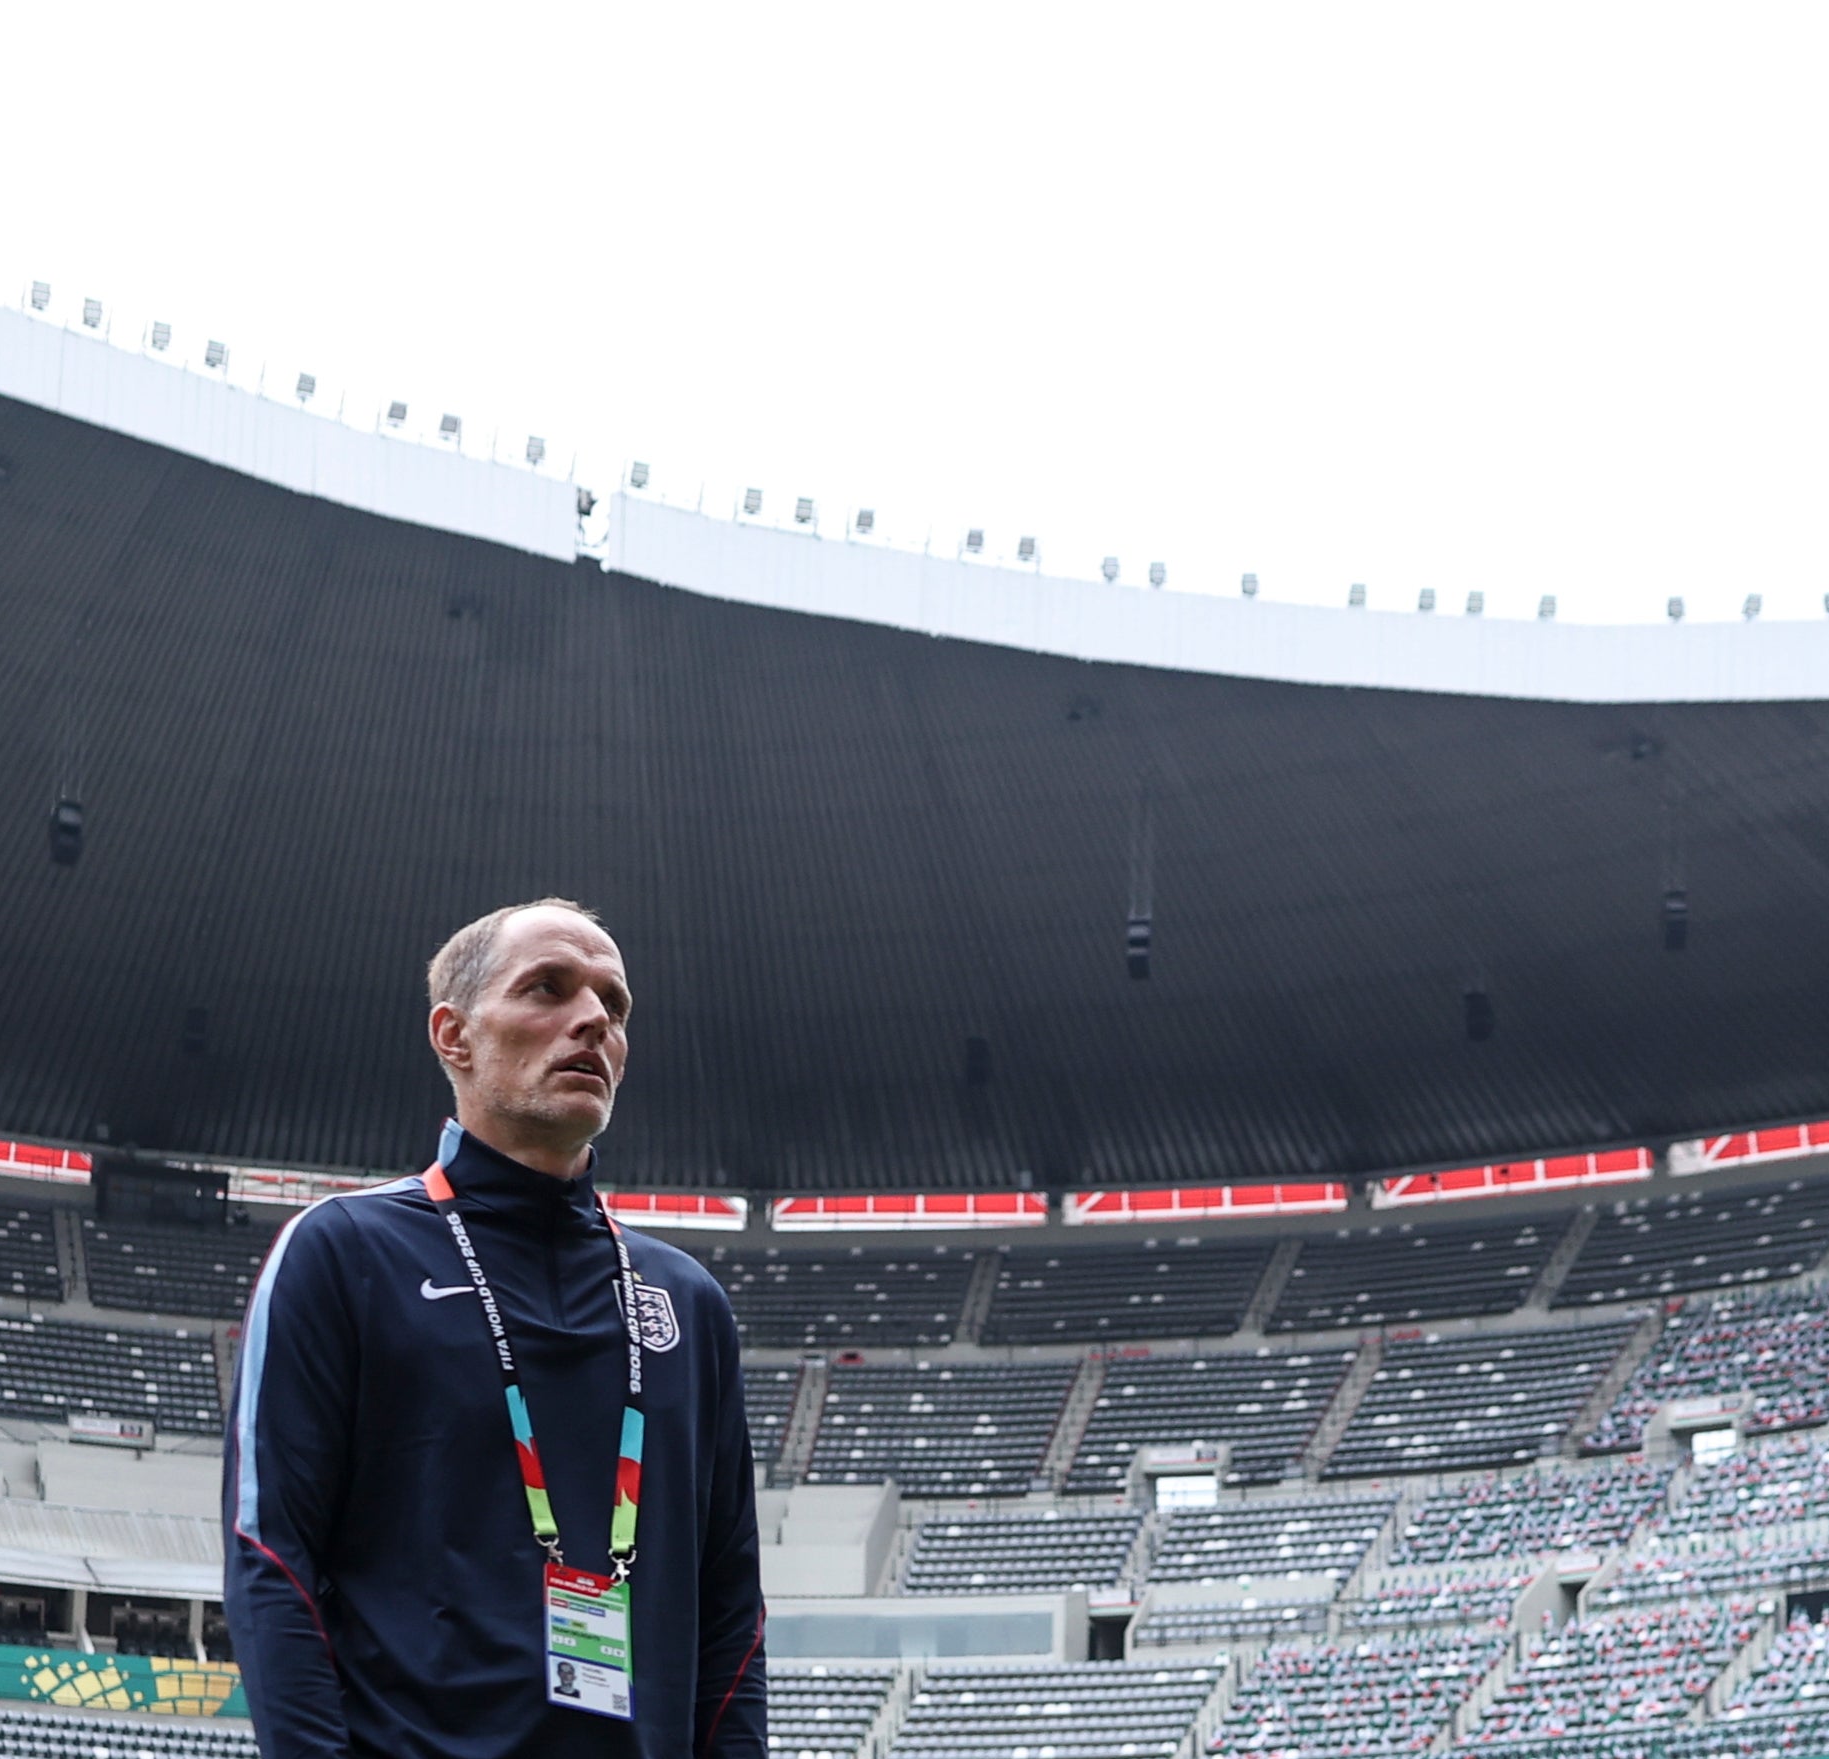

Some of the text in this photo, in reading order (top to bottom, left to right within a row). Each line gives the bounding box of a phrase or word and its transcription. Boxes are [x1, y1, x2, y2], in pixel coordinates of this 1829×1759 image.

[446, 1211, 514, 1370] FIFA WORLD CUP 2026
[617, 1242, 642, 1393] FIFA WORLD CUP 2026
